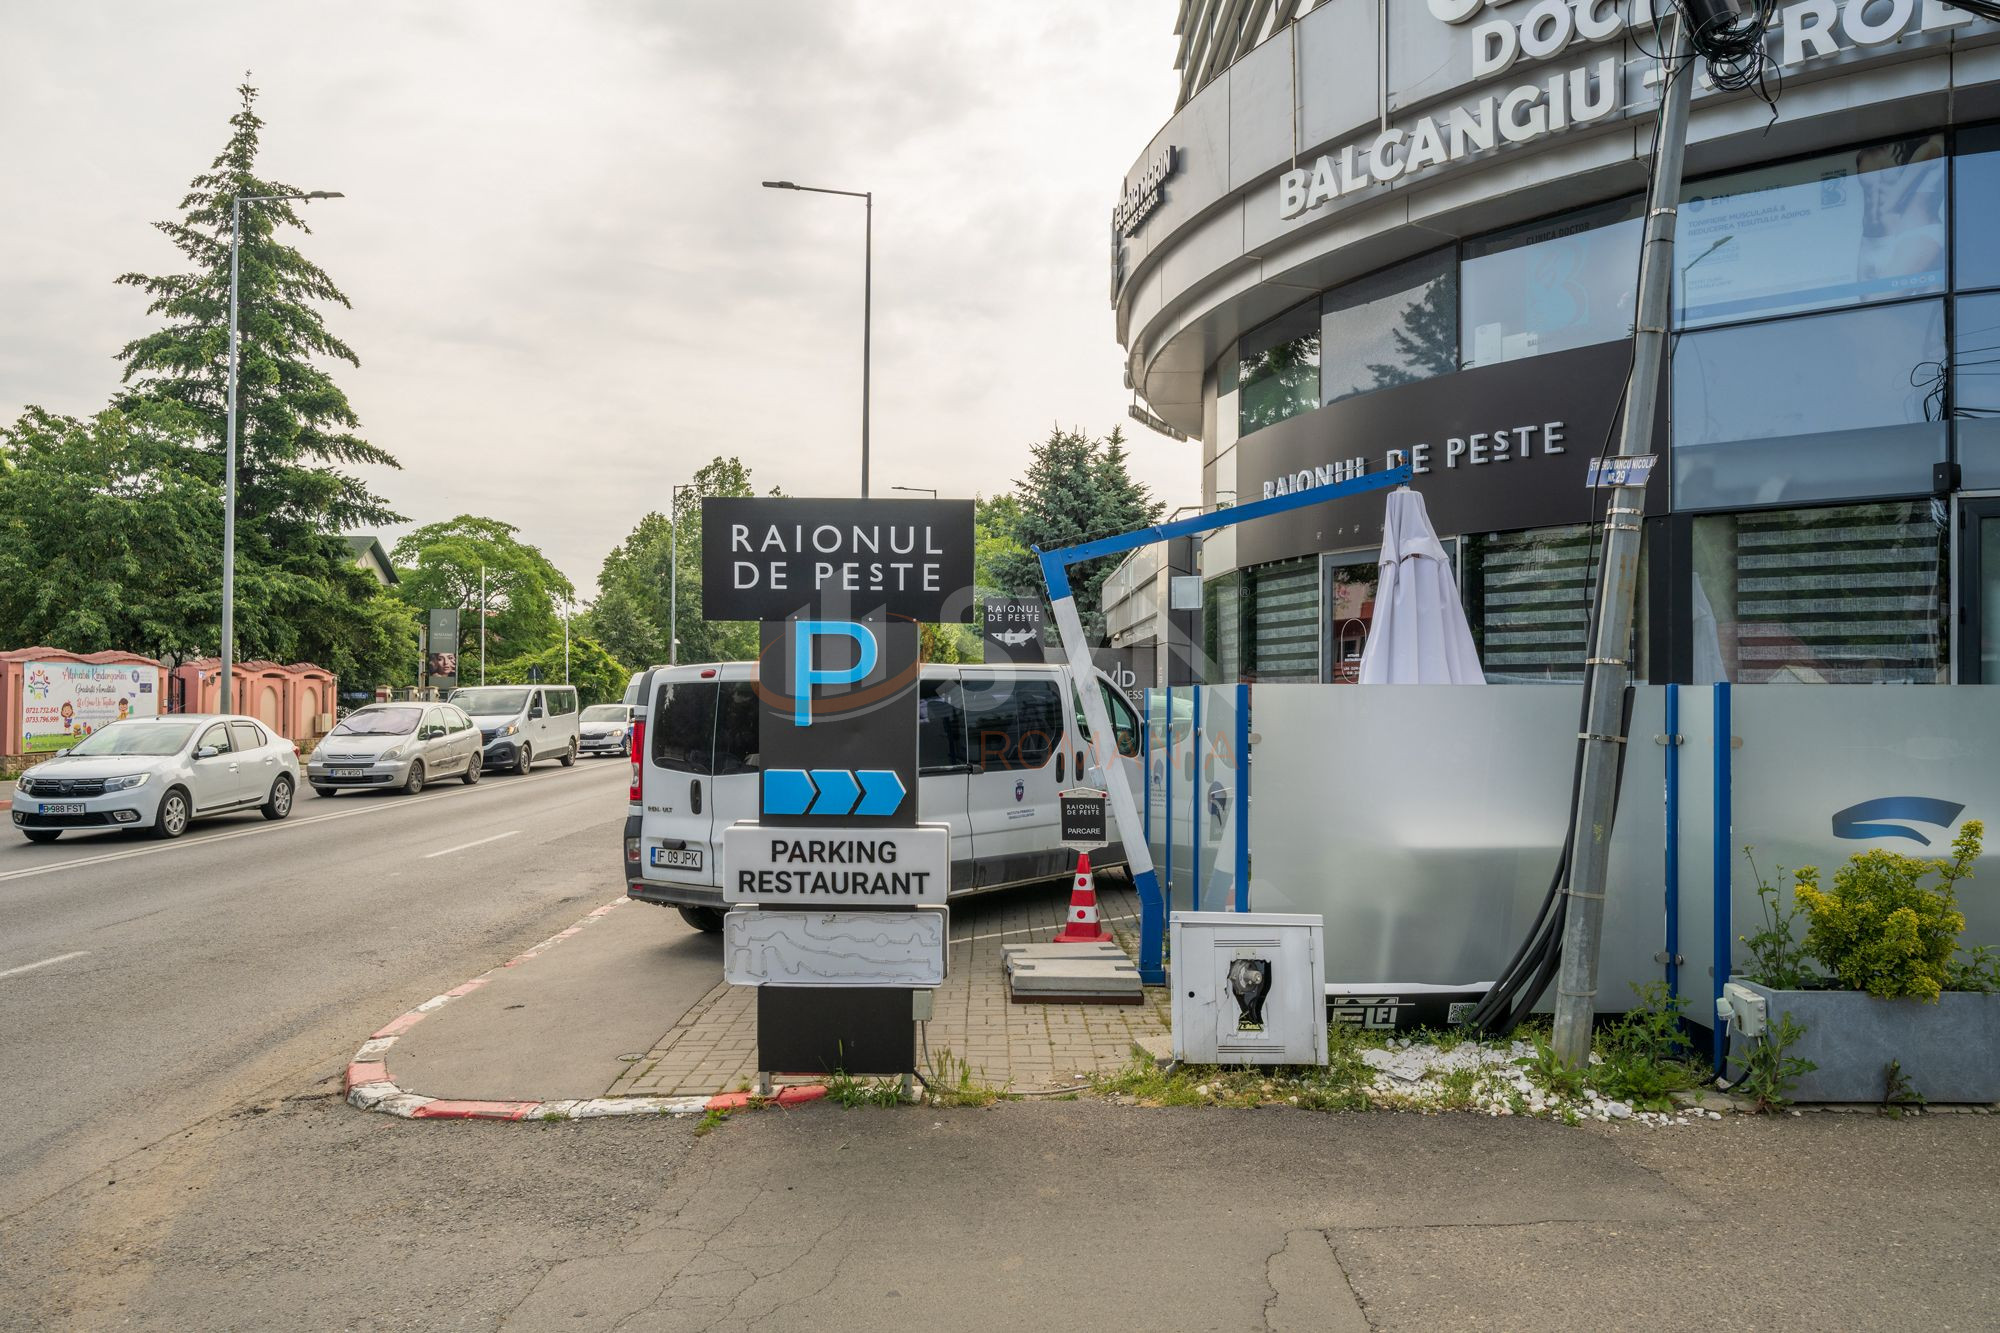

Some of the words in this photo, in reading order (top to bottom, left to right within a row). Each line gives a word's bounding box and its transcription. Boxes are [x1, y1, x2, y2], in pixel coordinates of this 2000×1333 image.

[1280, 57, 1618, 220] BALCANGIU
[1140, 145, 1176, 203] MARIN
[1446, 421, 1565, 468] PESTE
[1616, 470, 1626, 483] 29
[732, 524, 943, 554] RAIONUL
[734, 561, 788, 590] DE
[815, 562, 940, 592] PESTE
[987, 604, 1040, 613] RAIONUL
[988, 613, 1003, 622] DE
[795, 620, 878, 727] P
[66, 804, 83, 813] FST
[1067, 827, 1101, 835] PARCARE
[657, 850, 666, 862] IF
[667, 851, 679, 864] 09
[680, 852, 698, 866] JPK
[771, 839, 897, 864] PARKING
[738, 869, 931, 895] RESTAURANT
